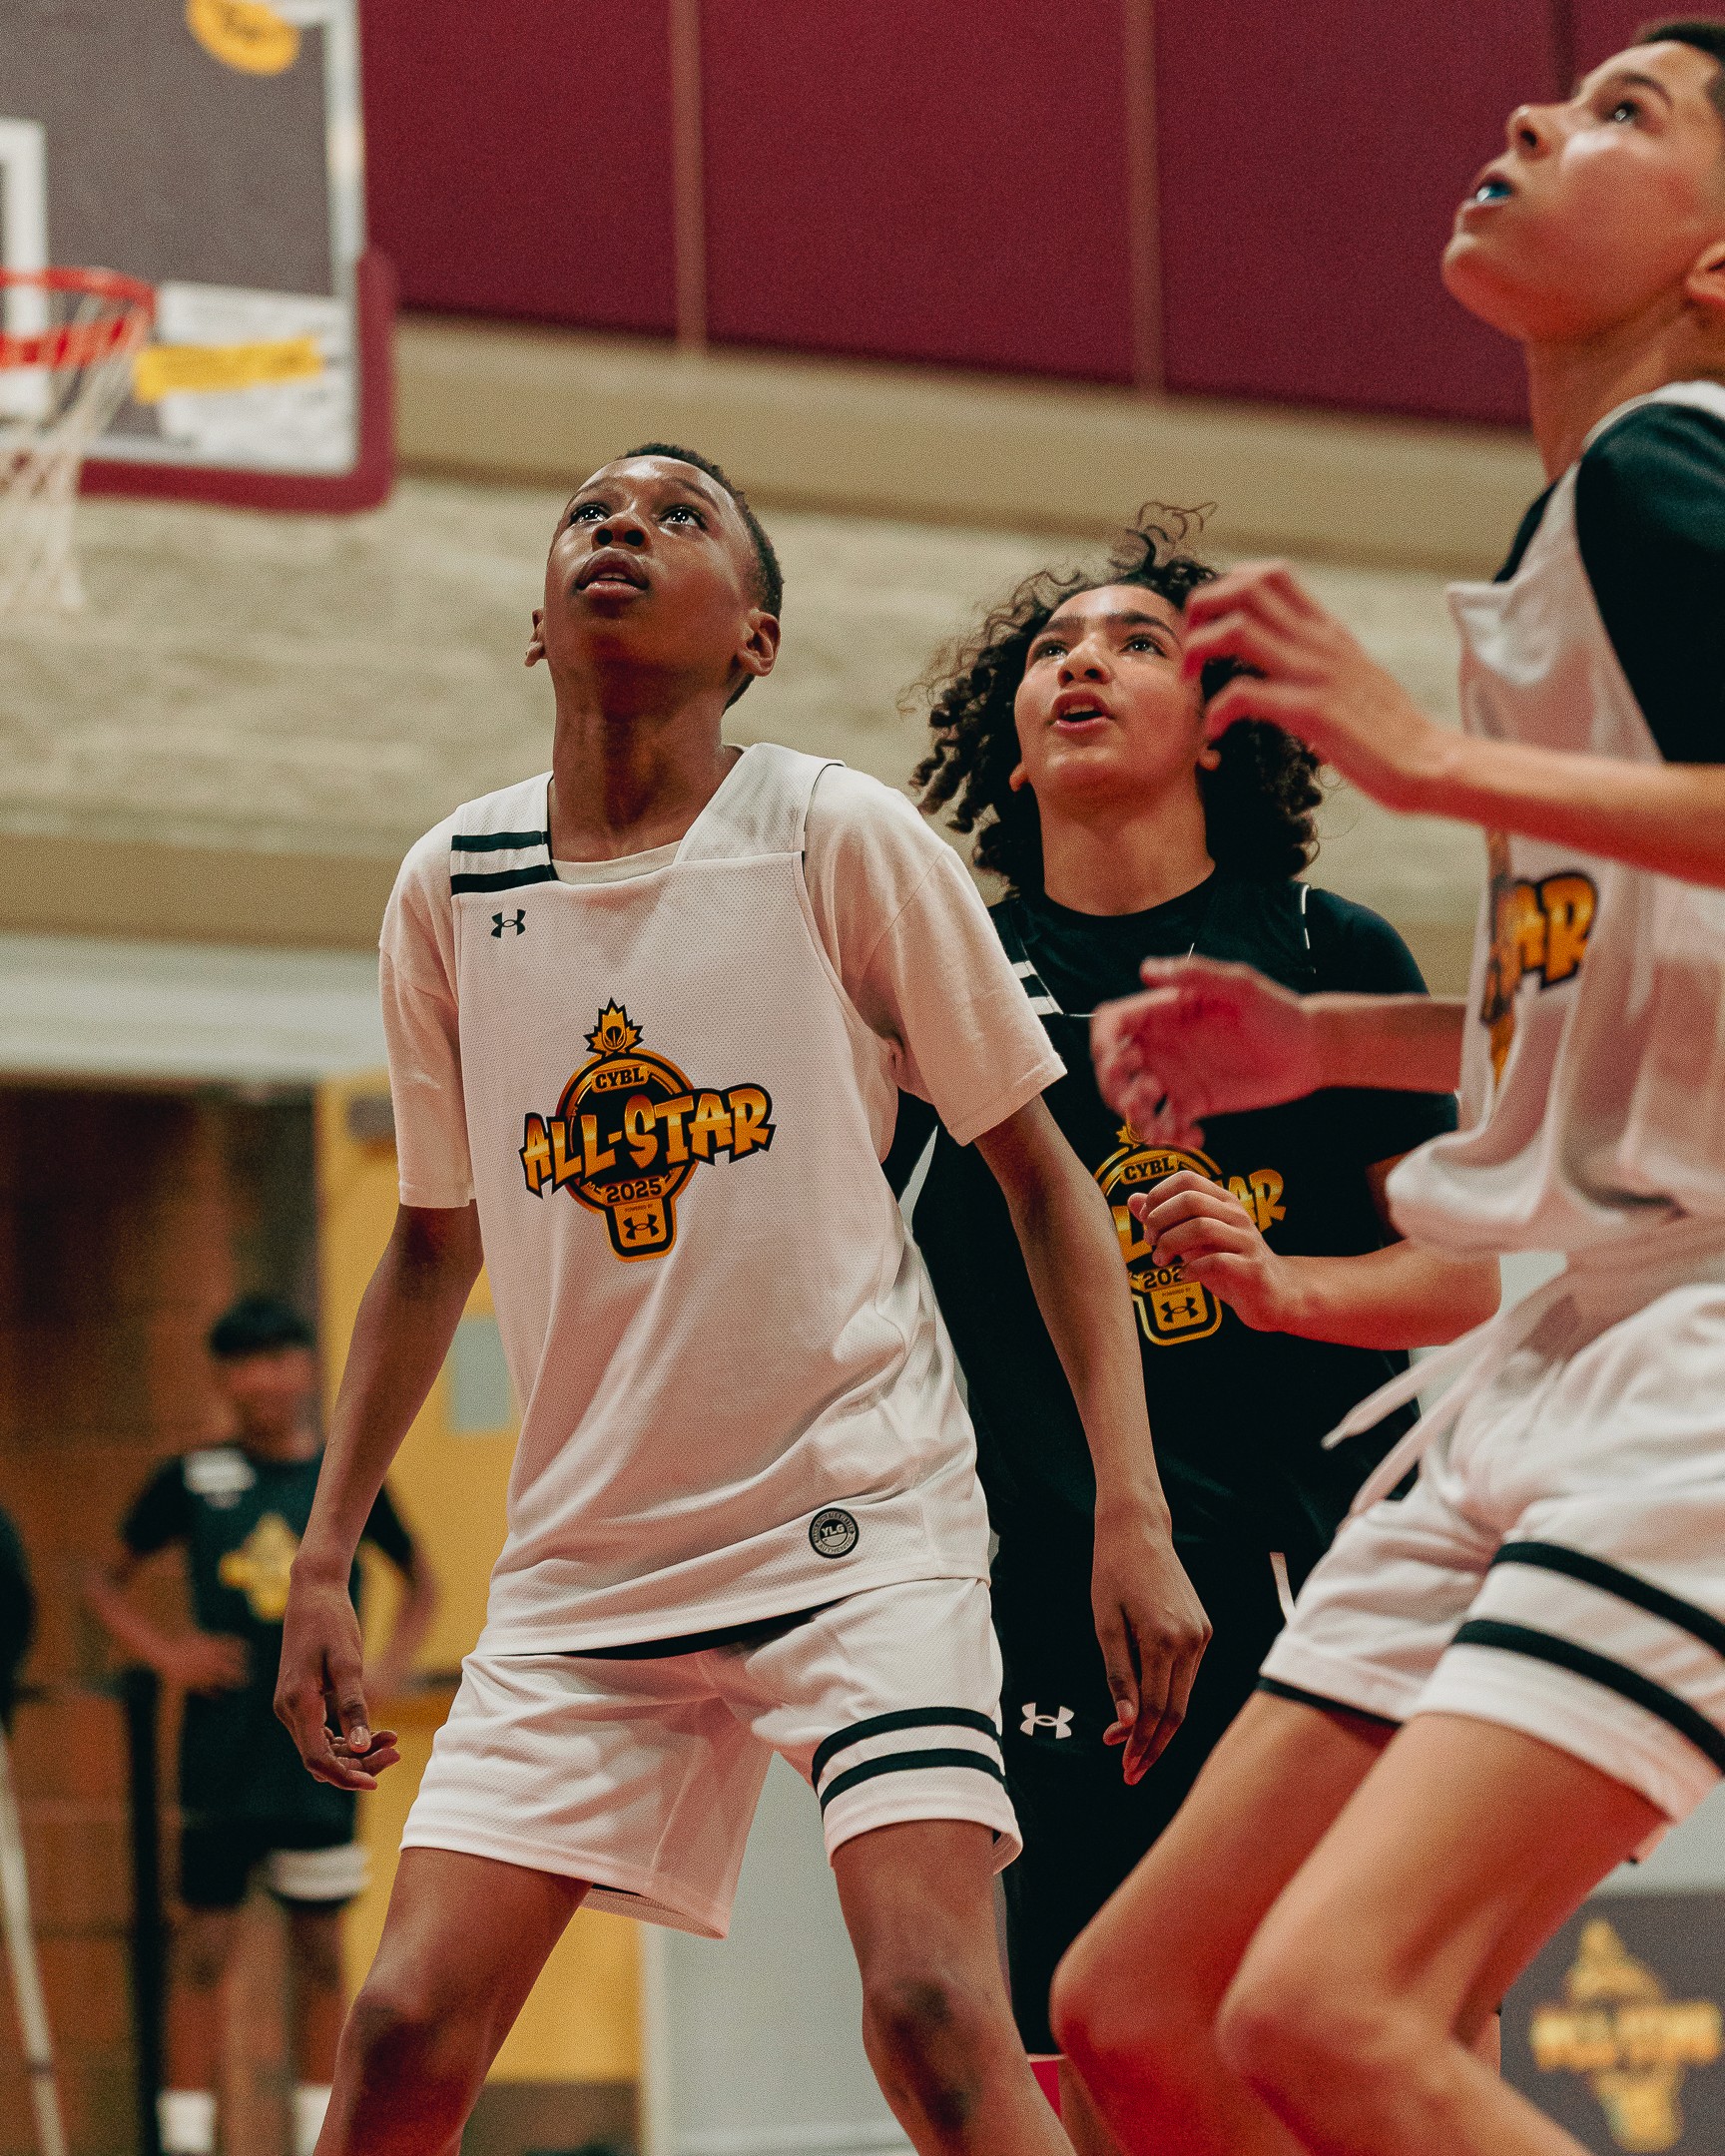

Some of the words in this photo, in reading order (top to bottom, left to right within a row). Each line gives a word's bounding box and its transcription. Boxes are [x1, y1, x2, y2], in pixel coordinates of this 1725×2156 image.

[595, 1067, 644, 1089] CYBL
[520, 1084, 775, 1197] ALL-STAR
[1125, 1157, 1174, 1180] CYBL
[605, 1177, 662, 1203] 2025
[1143, 1265, 1183, 1290] 202
[822, 1523, 846, 1536] YLG
